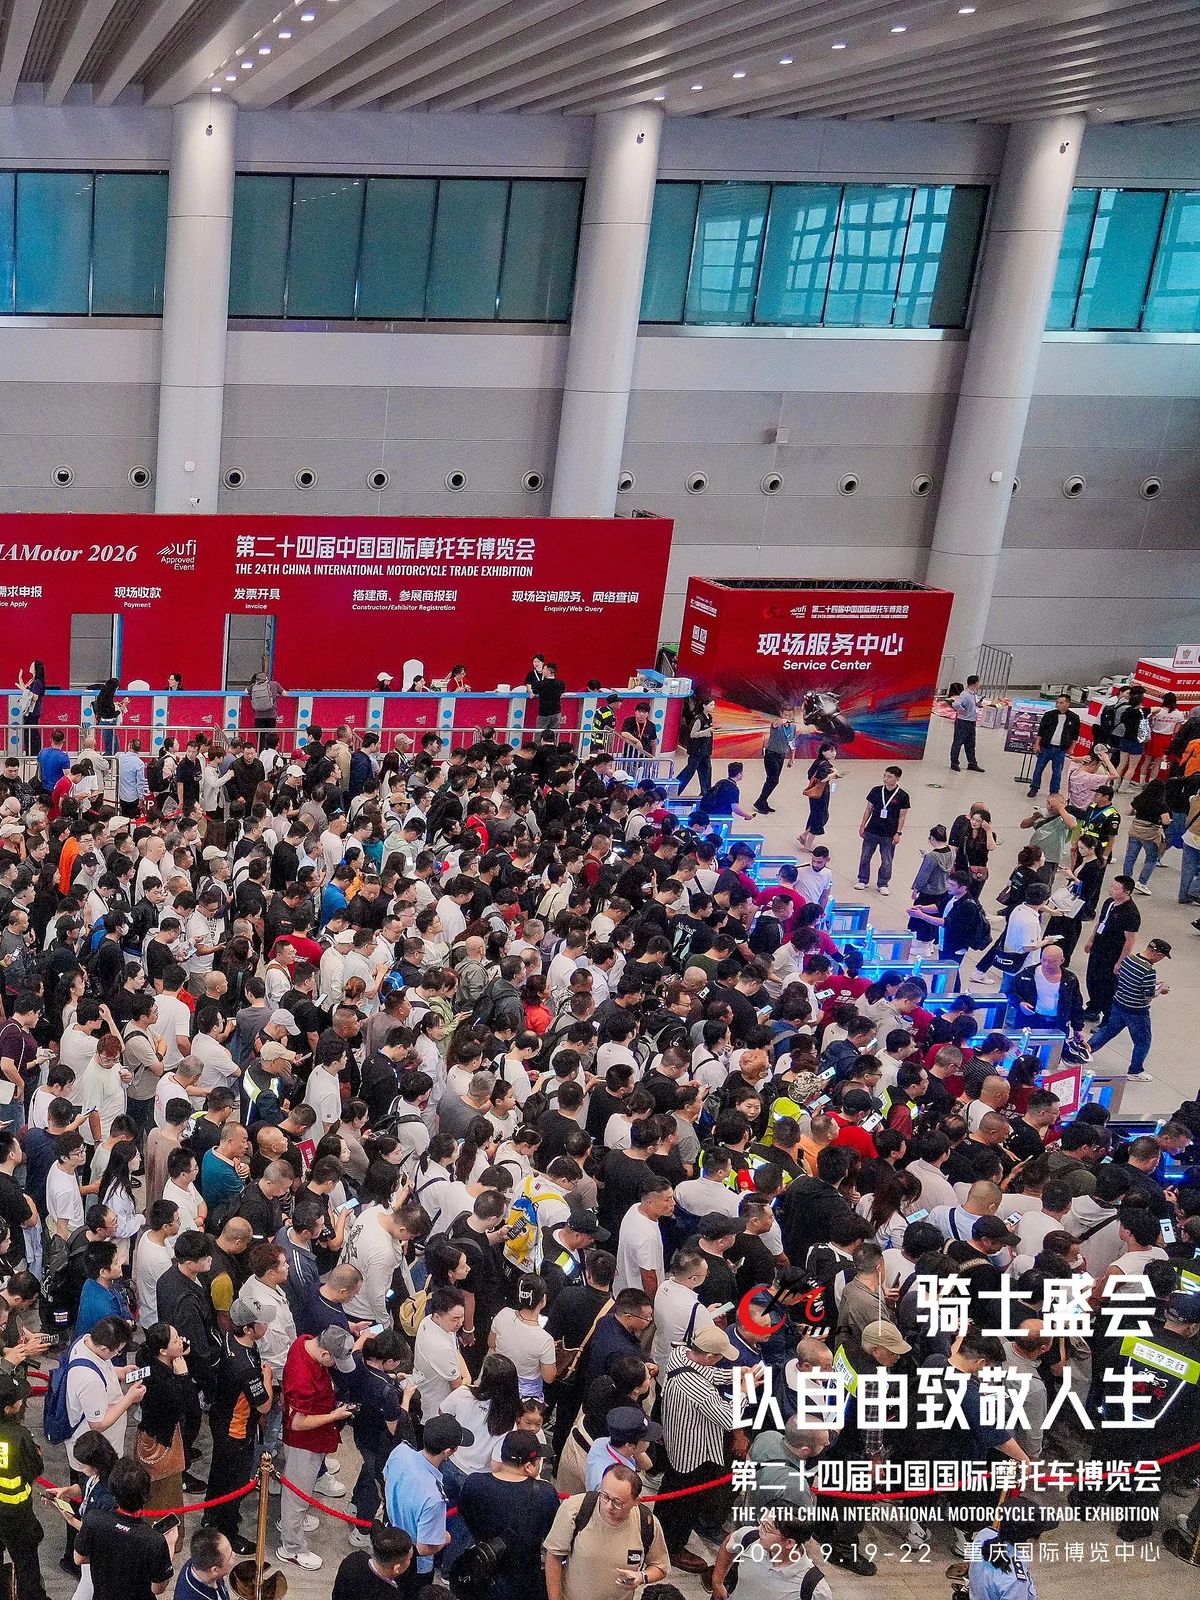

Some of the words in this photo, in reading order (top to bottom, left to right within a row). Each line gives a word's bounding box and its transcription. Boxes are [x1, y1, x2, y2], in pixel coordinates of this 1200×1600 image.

[87, 544, 139, 562] 2026
[176, 539, 197, 556] ufi
[236, 534, 536, 561] 第二十四届中国国际摩托车博览会
[160, 556, 195, 565] Approved
[173, 563, 195, 571] Event
[235, 563, 253, 576] THE
[254, 563, 280, 576] 24TH
[282, 563, 312, 576] CHINA
[313, 563, 384, 576] INTERNATIONAL
[386, 565, 448, 577] MOTORCYCLE
[449, 565, 480, 577] TRADE
[481, 565, 534, 577] EXHIBITION
[113, 586, 162, 599] 现场收款
[233, 587, 281, 600] 发票开具
[352, 589, 458, 602] 搭建商、参展商报到
[511, 590, 640, 604] 现场咨询服务、网络查询
[10, 600, 29, 608] Apply
[123, 601, 151, 609] Payment
[351, 603, 418, 611] Constructor/Exhibitor
[418, 604, 456, 612] Registration
[543, 605, 583, 613] Enquiry/Web
[584, 605, 604, 613] Query
[756, 632, 904, 656] 现场服务中心
[782, 659, 827, 670] Service
[830, 659, 872, 670] Center
